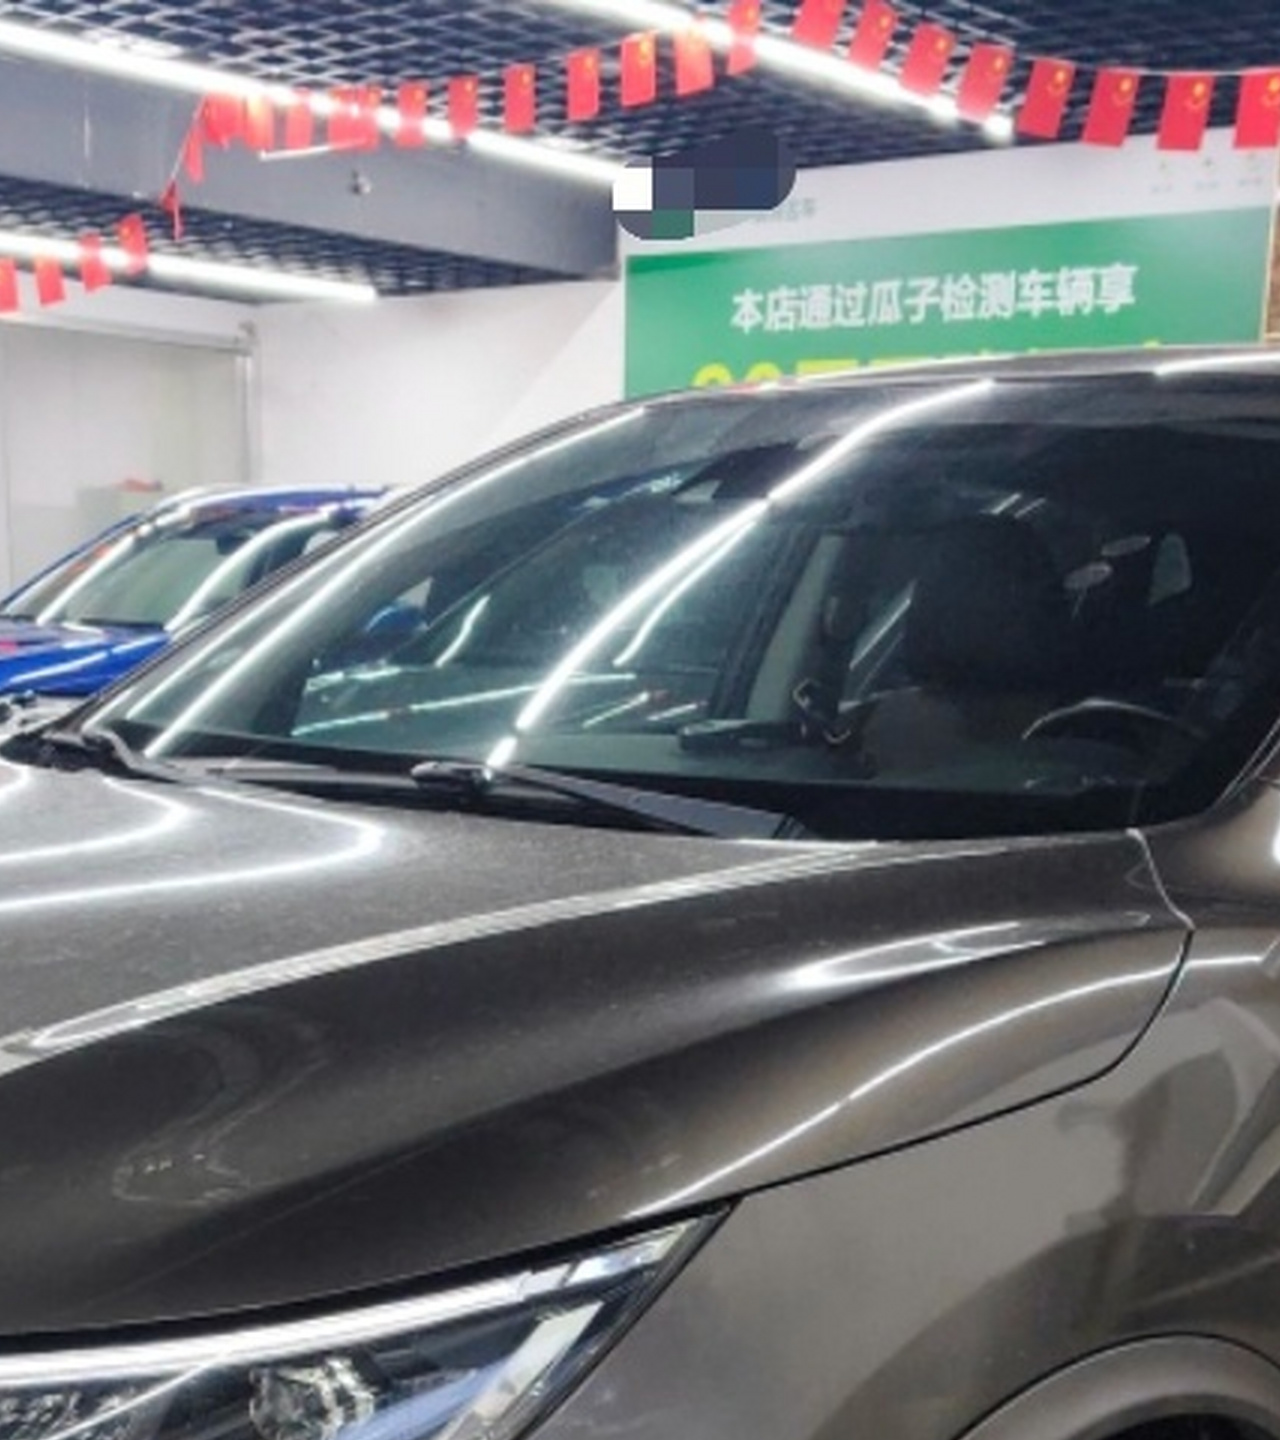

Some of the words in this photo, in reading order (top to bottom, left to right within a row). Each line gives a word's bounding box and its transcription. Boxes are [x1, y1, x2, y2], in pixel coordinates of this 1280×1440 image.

[730, 263, 1138, 334] 本店通过瓜子检测车辆享
